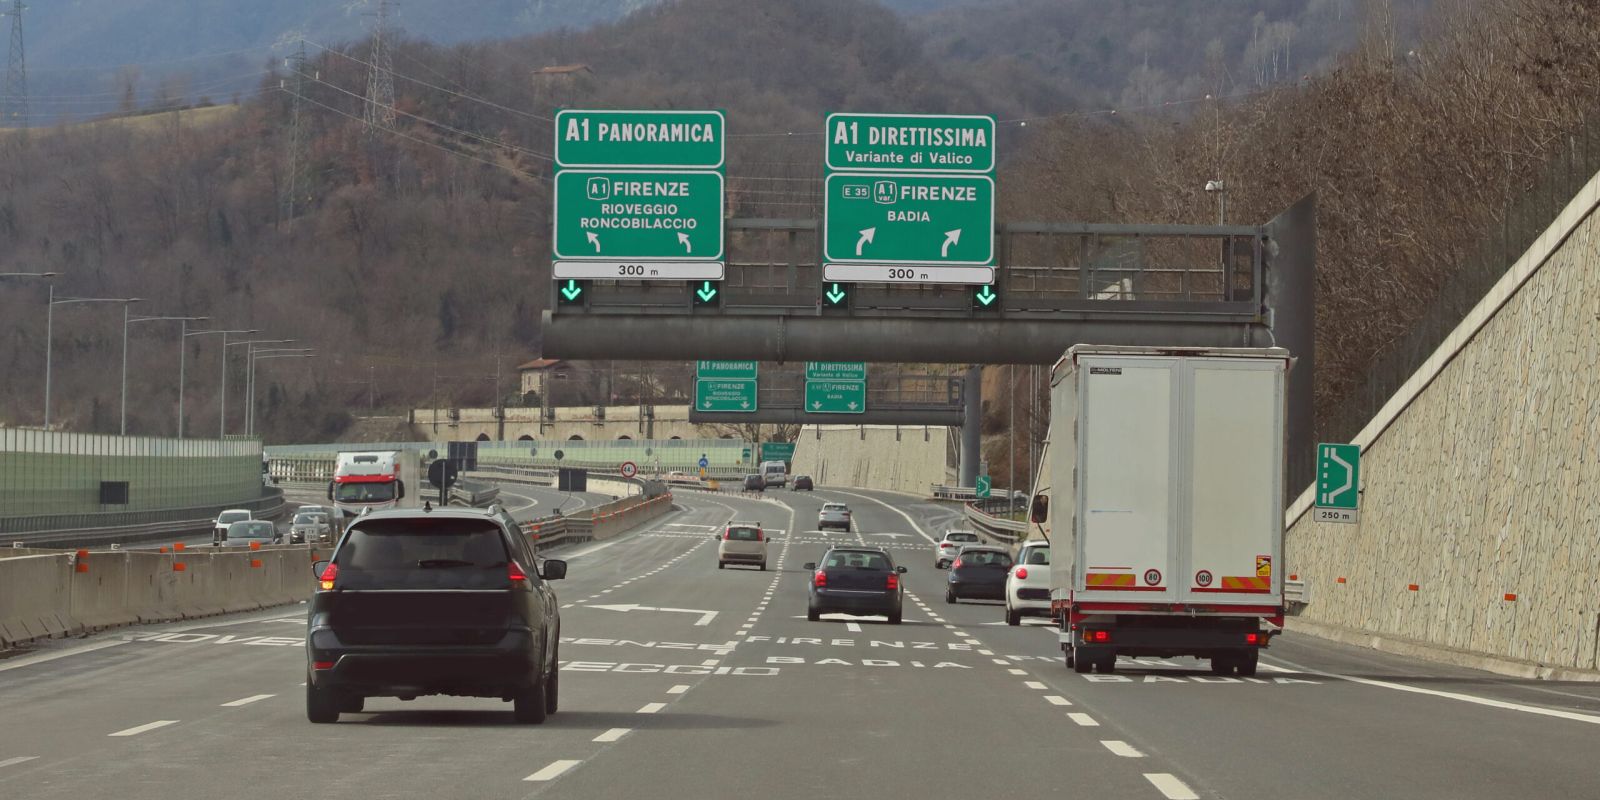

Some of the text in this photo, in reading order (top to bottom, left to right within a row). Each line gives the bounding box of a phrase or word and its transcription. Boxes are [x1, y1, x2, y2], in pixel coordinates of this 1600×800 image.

[565, 118, 714, 142] A1 PANORAMICA
[834, 121, 987, 147] A1 DIRETTISSIMA
[846, 150, 973, 165] Variante di Valico
[613, 181, 690, 197] FIRENZE
[855, 187, 868, 197] 35
[901, 186, 977, 201] FIRENZE
[601, 203, 678, 216] RIOVEGGIO
[887, 210, 931, 222] BADIA
[580, 217, 697, 230] RONCOBILACCIO
[618, 265, 659, 276] 300 m
[888, 268, 915, 279] 300
[820, 363, 863, 371] DIRETTISSIMA
[1322, 511, 1340, 519] 250
[1148, 573, 1158, 582] 80
[1199, 574, 1210, 583] 100
[559, 637, 735, 651] ENZE
[745, 635, 975, 651] FIRENZE
[559, 660, 780, 677] EGGIO
[765, 656, 974, 669] BADIA
[1080, 673, 1323, 685] BADIA
